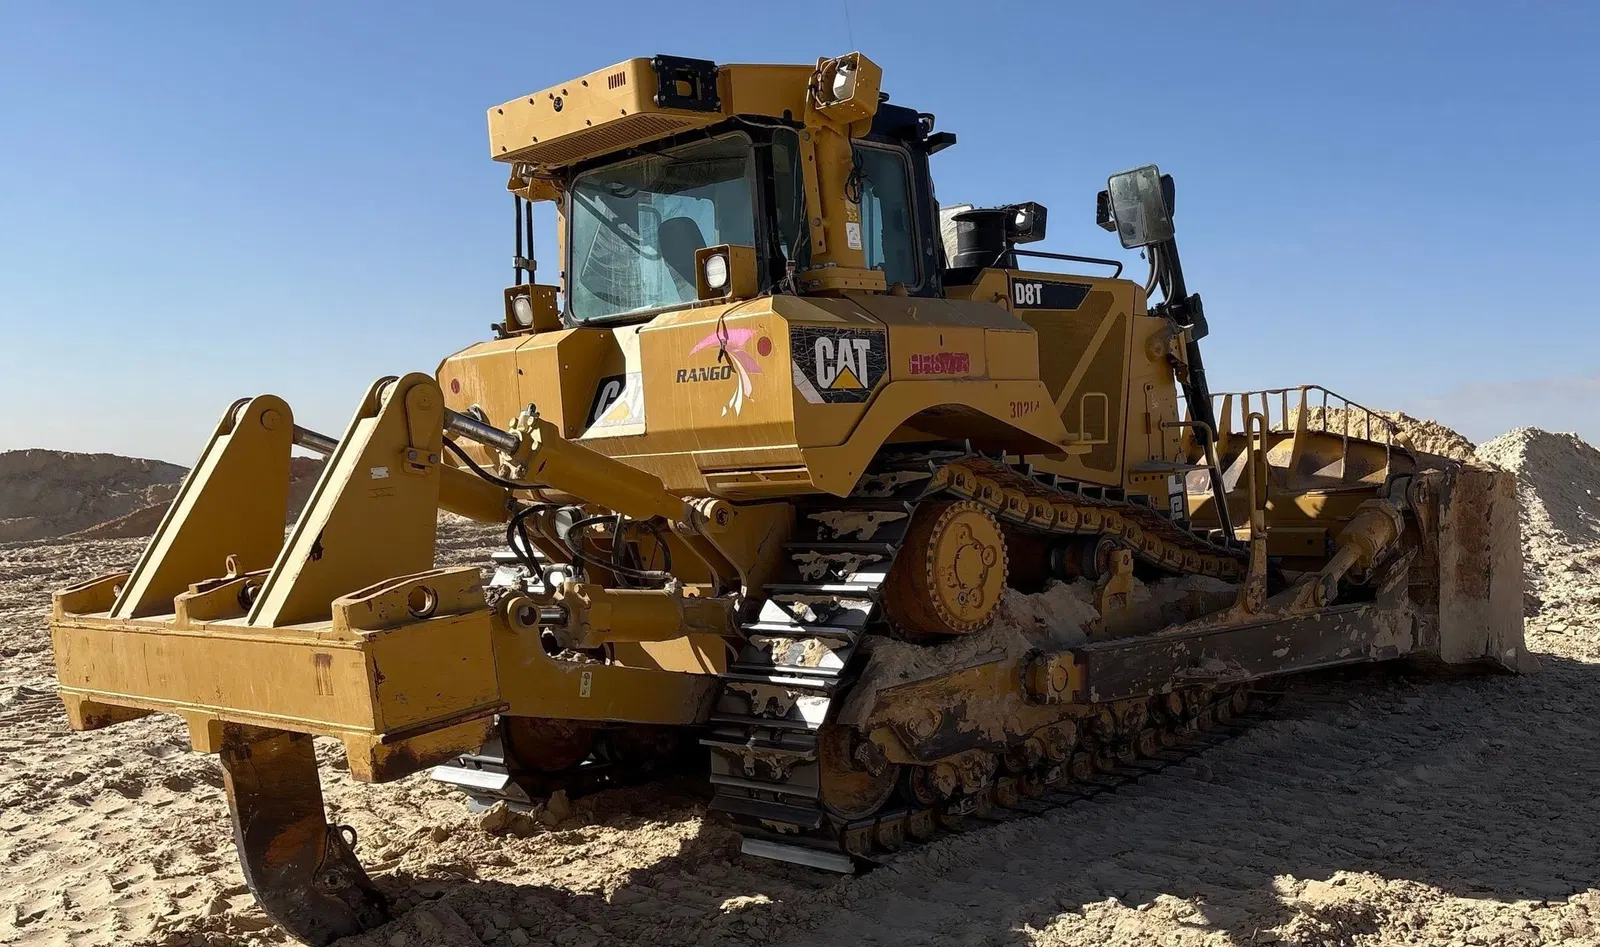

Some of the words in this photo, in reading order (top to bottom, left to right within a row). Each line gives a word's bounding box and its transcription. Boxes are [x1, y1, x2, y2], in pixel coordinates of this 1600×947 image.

[1015, 283, 1042, 304] D8T
[815, 336, 870, 389] CAT
[676, 365, 731, 383] RANGO
